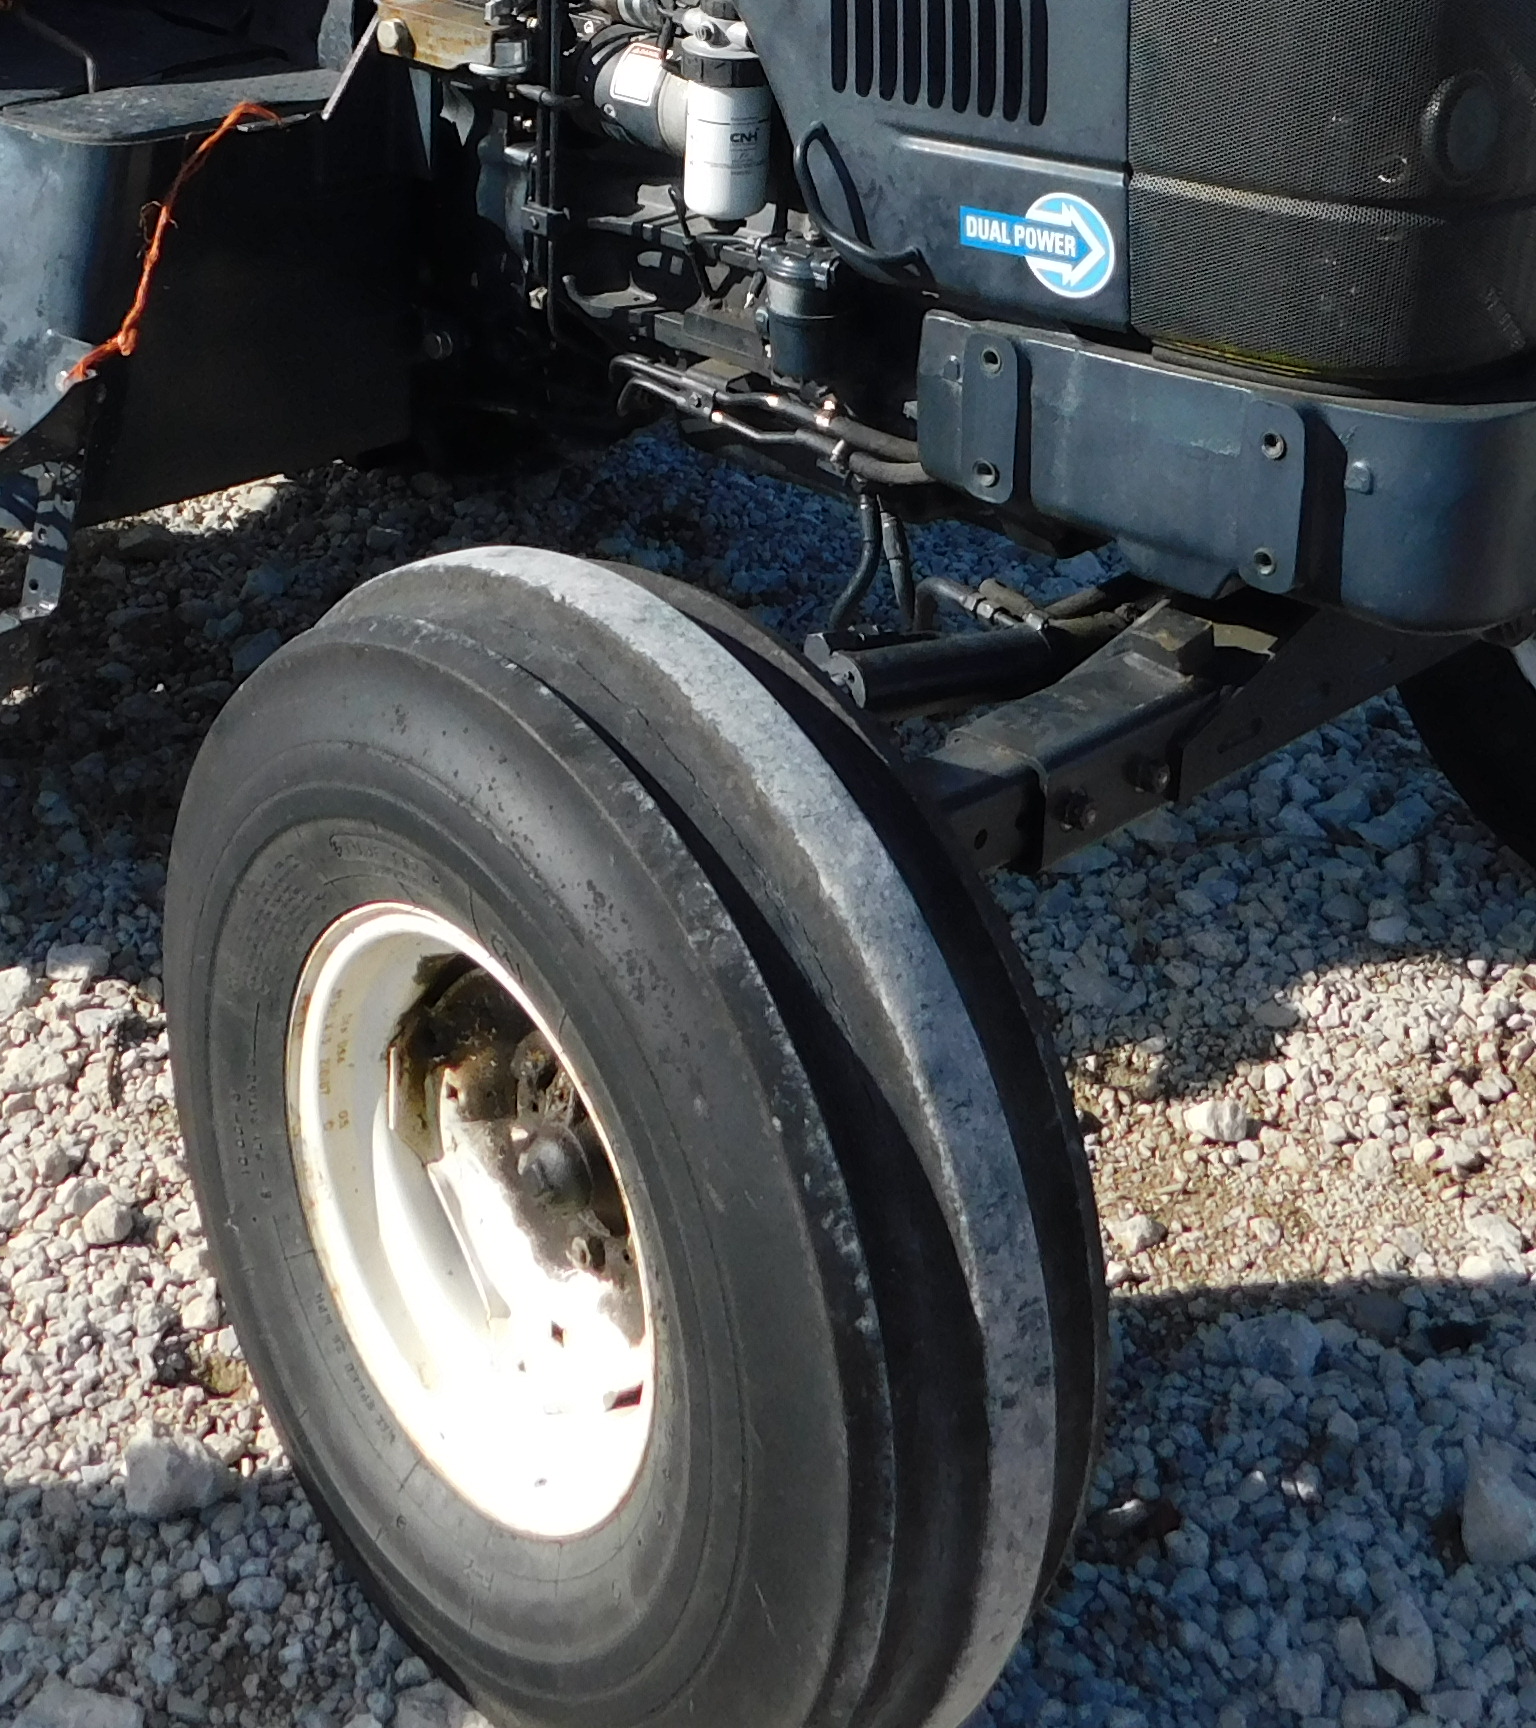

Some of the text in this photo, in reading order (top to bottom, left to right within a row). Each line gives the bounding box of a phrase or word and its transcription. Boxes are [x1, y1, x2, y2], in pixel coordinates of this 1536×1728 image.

[729, 131, 758, 144] CNH
[965, 214, 1077, 258] DUAL POWER
